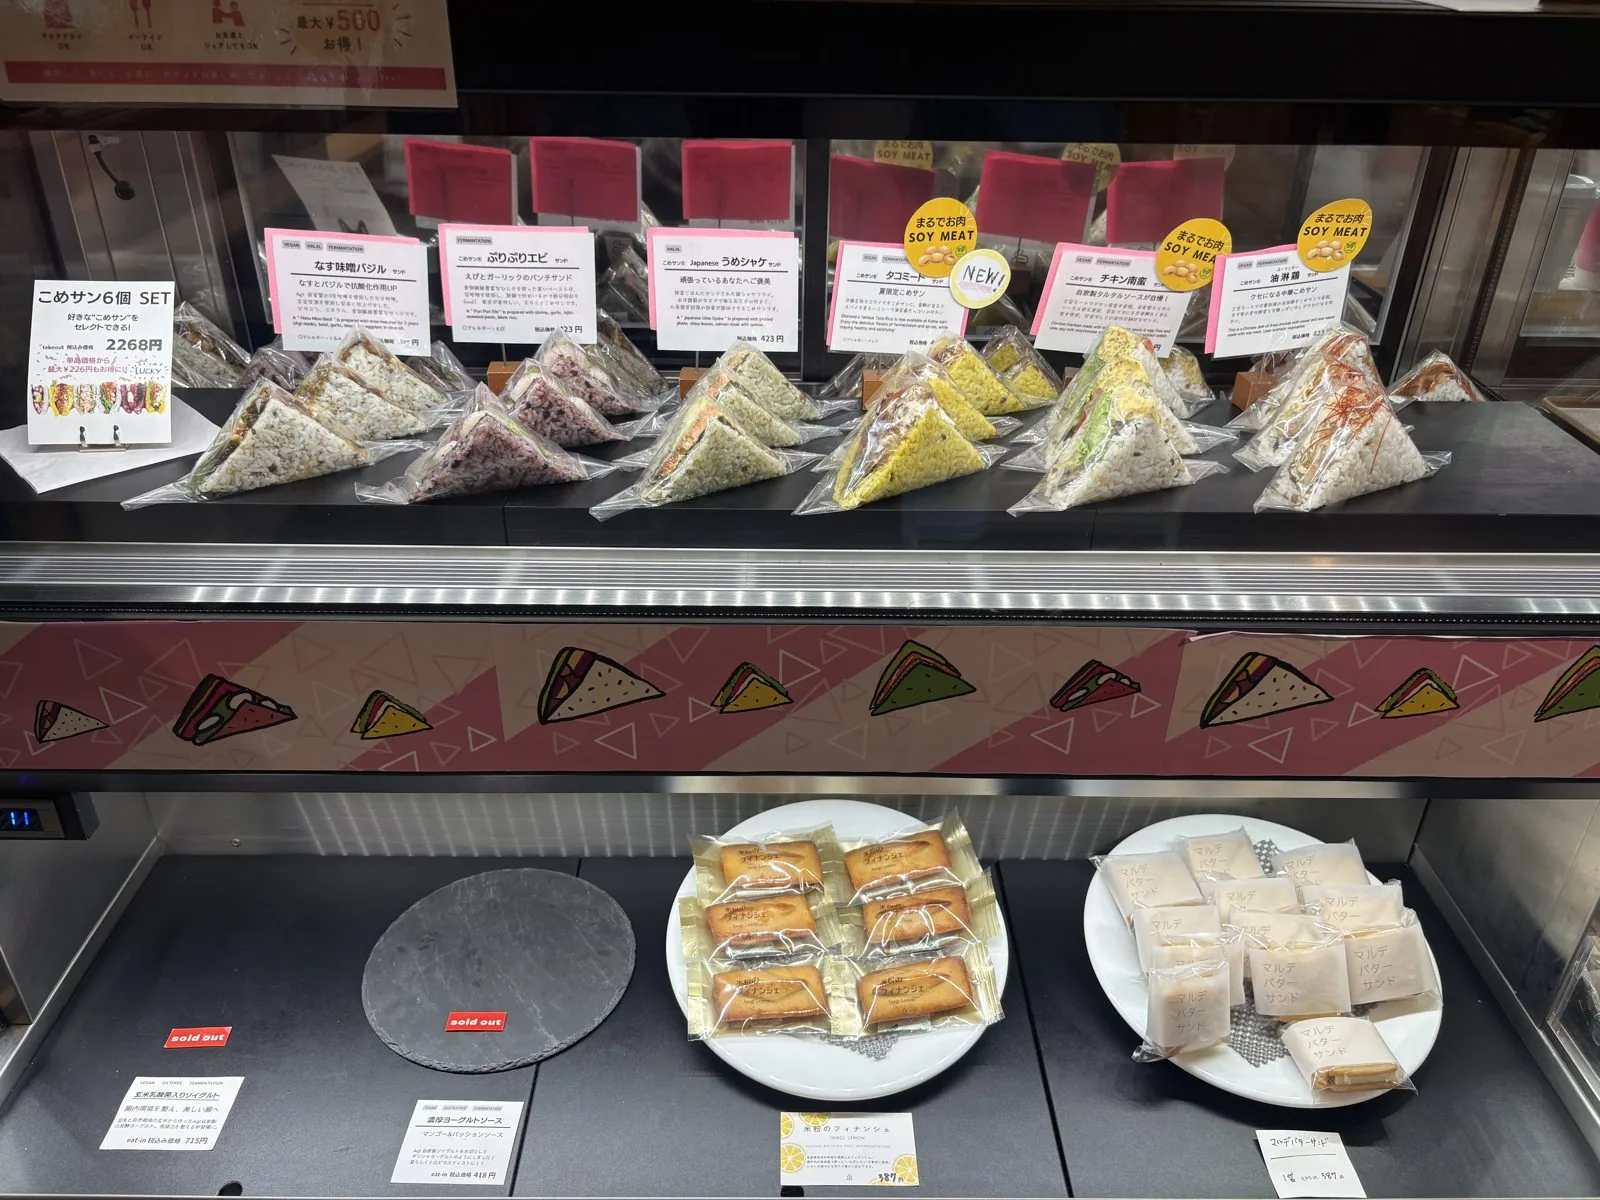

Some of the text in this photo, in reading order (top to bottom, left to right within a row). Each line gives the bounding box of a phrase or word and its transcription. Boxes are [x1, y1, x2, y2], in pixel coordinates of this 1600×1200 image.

[57, 42, 71, 50] OK
[141, 43, 154, 51] OK
[878, 150, 931, 160] SOY MEAT
[916, 216, 966, 228] まるでお肉
[1314, 213, 1364, 223] まるでお肉
[909, 230, 974, 242] SOY MEAT
[1303, 226, 1368, 237] SOY MEAT
[1177, 230, 1225, 251] まるでお肉
[487, 252, 548, 264] ぷりぷりエビ
[1164, 241, 1216, 264] SOY MEA
[314, 261, 387, 275] なす味噌バジル
[721, 257, 767, 267] うめシャケ
[465, 272, 573, 282] えびとガーリックのパンチサンド
[679, 276, 772, 286] 頑張っているあなたへご褒美
[886, 270, 926, 282] タコミート
[962, 264, 1006, 293] NEW!
[1100, 273, 1148, 286] チキン南蛮
[1270, 270, 1300, 283] 油淋鶏
[299, 280, 398, 292] なすとバジルで抗酸化作用UP
[38, 291, 171, 305] こめサン6個 SET
[878, 287, 925, 298] 夏限定こめサン
[1076, 289, 1168, 302] 自家製タルタルソースが自慢！
[1250, 286, 1318, 301] クセになる中華こめサン
[574, 325, 583, 333] 円
[105, 338, 163, 351] 2268円
[411, 339, 419, 347] 円
[760, 335, 774, 343] 423
[776, 335, 784, 343] 円
[1153, 343, 1162, 351] 円
[66, 356, 111, 365] 単品価格から
[135, 367, 162, 375] LUCKY
[10, 811, 29, 826] 11
[1194, 843, 1224, 855] マルデ
[864, 852, 904, 865] フィナンシェ
[1199, 858, 1227, 869] バター
[1285, 855, 1316, 870] マルデ
[1120, 864, 1149, 876] マルデ
[1292, 868, 1320, 881] バター
[1126, 877, 1155, 889] バター
[1131, 887, 1160, 900] サンド
[1225, 890, 1257, 902] マルデ
[1324, 895, 1359, 907] マルデ
[1327, 911, 1361, 922] バター
[1151, 917, 1183, 930] マルデ
[1354, 945, 1389, 960] マルデ
[1262, 962, 1297, 974] マルデ
[1359, 962, 1394, 976] バター
[1264, 977, 1298, 989] バター
[1363, 976, 1396, 990] サンド
[1177, 990, 1208, 1003] マルデ
[1264, 993, 1300, 1004] サンド
[1176, 1007, 1207, 1018] バター
[450, 1017, 502, 1026] sold out
[1175, 1023, 1205, 1034] サンド
[1301, 1024, 1336, 1038] マルデ
[170, 1033, 225, 1042] sold out
[1307, 1037, 1342, 1049] バター
[1313, 1048, 1348, 1060] サンド
[133, 1091, 220, 1099] 玄米乳酸菌入りソイグルト
[426, 1116, 502, 1124] 濃厚ヨーグルトソース
[803, 1125, 890, 1133] 米粉のフィナンシェ
[185, 1137, 208, 1145] 715円
[488, 1172, 497, 1180] 円
[878, 1172, 897, 1183] 387
[1320, 1171, 1337, 1181] 387
